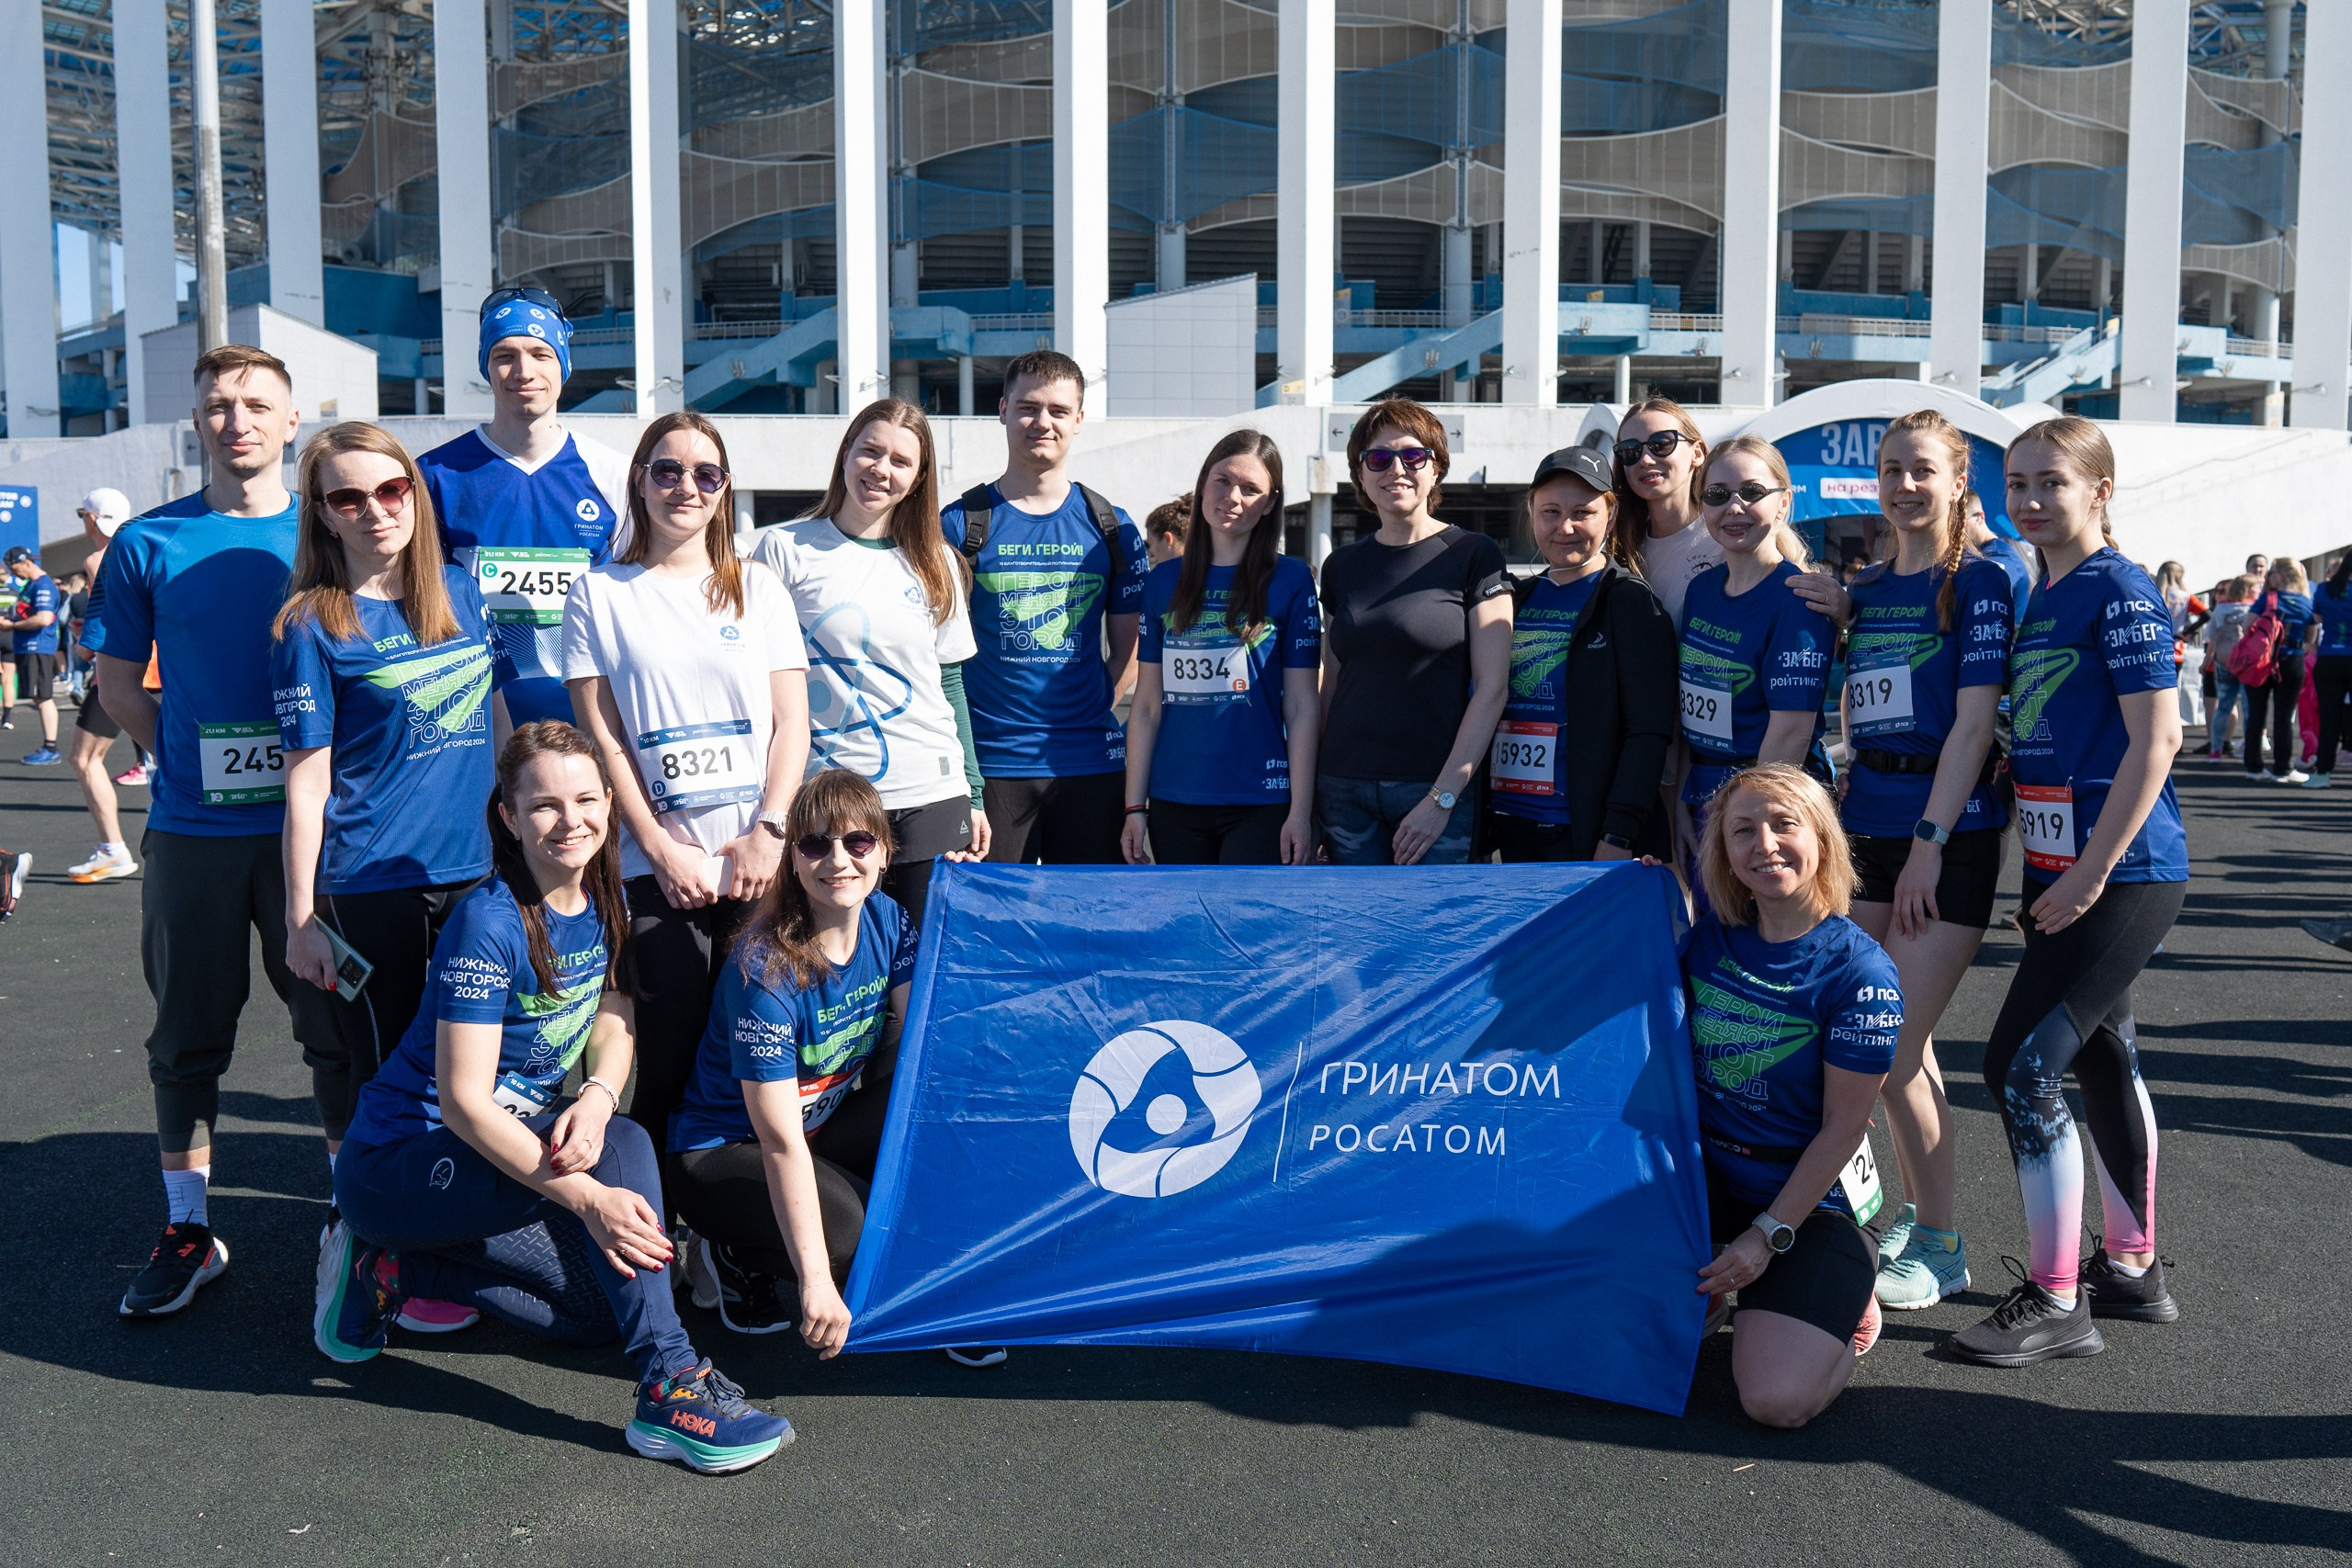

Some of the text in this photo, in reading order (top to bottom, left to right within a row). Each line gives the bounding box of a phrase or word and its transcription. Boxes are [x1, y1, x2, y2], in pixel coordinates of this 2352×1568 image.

[1827, 484, 1847, 492] на
[998, 542, 1084, 557] БЕГИ, ГЕРОЙ!
[500, 570, 571, 596] 2455
[998, 571, 1086, 592] ГЕРОИ
[999, 592, 1085, 608] МЕНЯЮТ
[1860, 604, 1928, 619] БЕГИ, ГЕРОЙ!
[2123, 600, 2154, 613] ПСБ
[999, 606, 1085, 631] ЭТОТ
[1689, 616, 1712, 637] БЕГИ,
[1710, 626, 1743, 645] ГЕРОЙ!
[372, 633, 416, 654] БЕГИ,
[1001, 630, 1082, 651] ГОРОД
[1512, 630, 1566, 647] ЕРОИ
[391, 645, 488, 685] ГЕРОИ
[1000, 655, 1031, 663] НИЖНИЙ
[1031, 656, 1069, 664] НОВГОРОД
[1173, 656, 1231, 681] 8334
[273, 682, 311, 701] ИЖНИЙ
[401, 666, 489, 701] МЕНЯЮТ
[1849, 678, 1894, 710] 8319
[275, 699, 317, 716] ОВГОРОД
[406, 683, 489, 727] ЭТОТ
[1679, 689, 1718, 722] 8329
[409, 709, 486, 750] ГОРОД
[222, 745, 285, 774] 245
[406, 745, 441, 761] НИЖНИЙ
[472, 738, 486, 746] 2024
[1495, 741, 1547, 768] 15932
[662, 746, 733, 780] 8321
[654, 783, 663, 795] D
[454, 986, 490, 999] 2024
[1696, 983, 1786, 1035] ГЕРОИ
[737, 1016, 793, 1035] НИЖНИЙ
[750, 1045, 783, 1057] 2024
[1319, 1061, 1560, 1099] ГРИНАТОМ
[1694, 1059, 1769, 1100] ОРОД
[1308, 1123, 1506, 1156] РОСАТОМ
[695, 1366, 711, 1380] HOKA
[670, 1409, 717, 1438] HOKA
